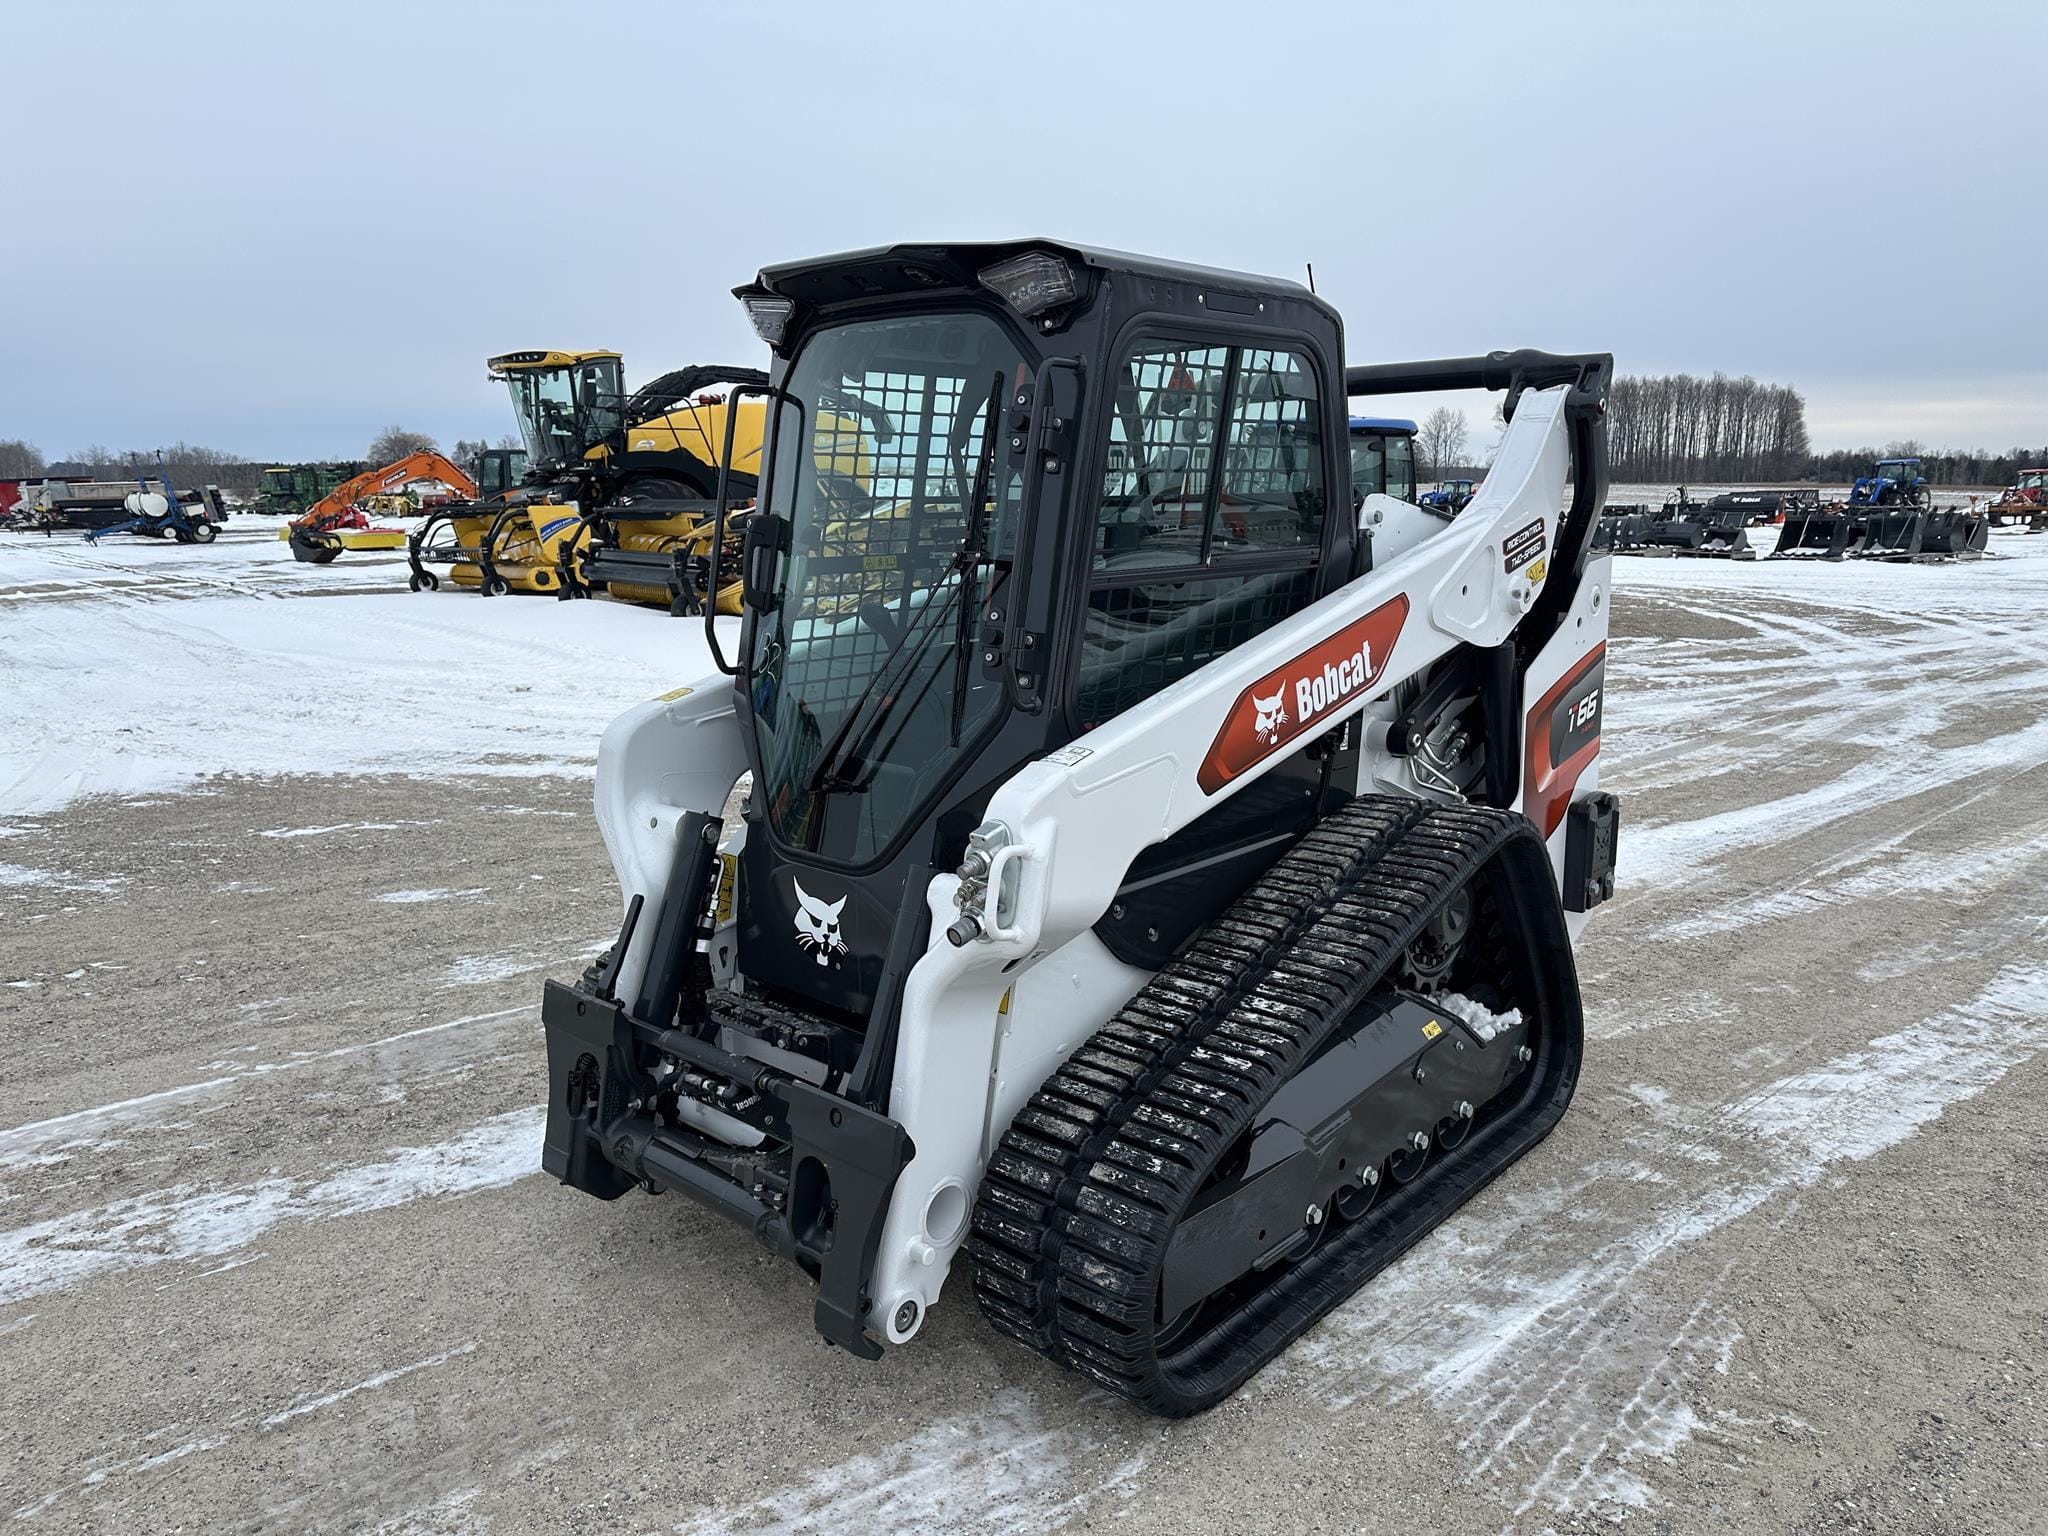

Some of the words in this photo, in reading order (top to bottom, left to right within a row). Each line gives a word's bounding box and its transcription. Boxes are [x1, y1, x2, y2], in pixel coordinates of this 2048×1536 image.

[1511, 540, 1542, 568] TWO-SPEED
[1295, 640, 1373, 723] Bobcat
[1568, 689, 1599, 733] T66
